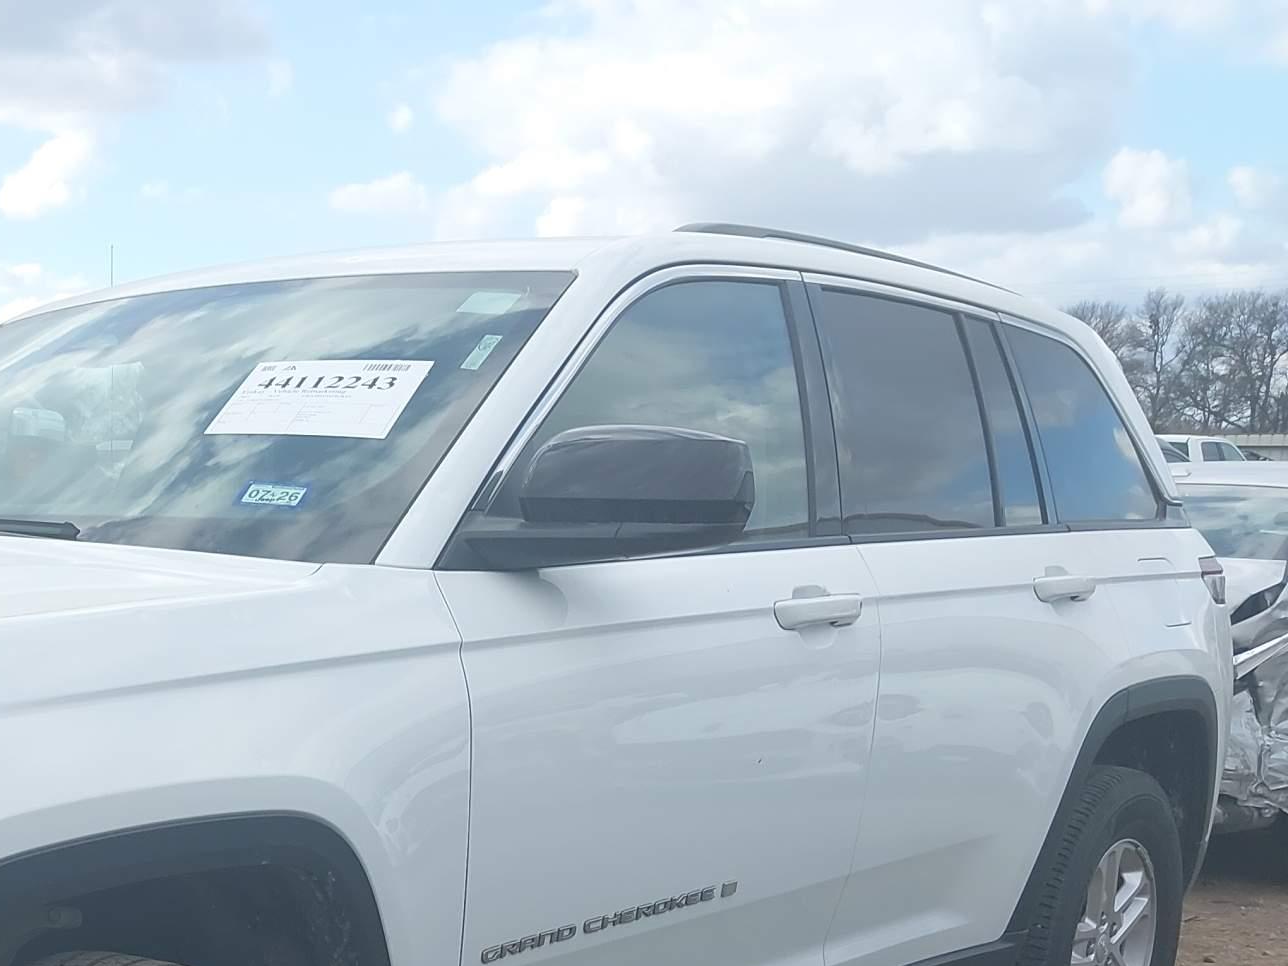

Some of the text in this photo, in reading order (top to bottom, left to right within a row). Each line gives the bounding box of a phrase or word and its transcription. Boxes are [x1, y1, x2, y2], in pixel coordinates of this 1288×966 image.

[257, 375, 398, 390] 44112243
[480, 885, 716, 964] GRAND CHEROKEE
